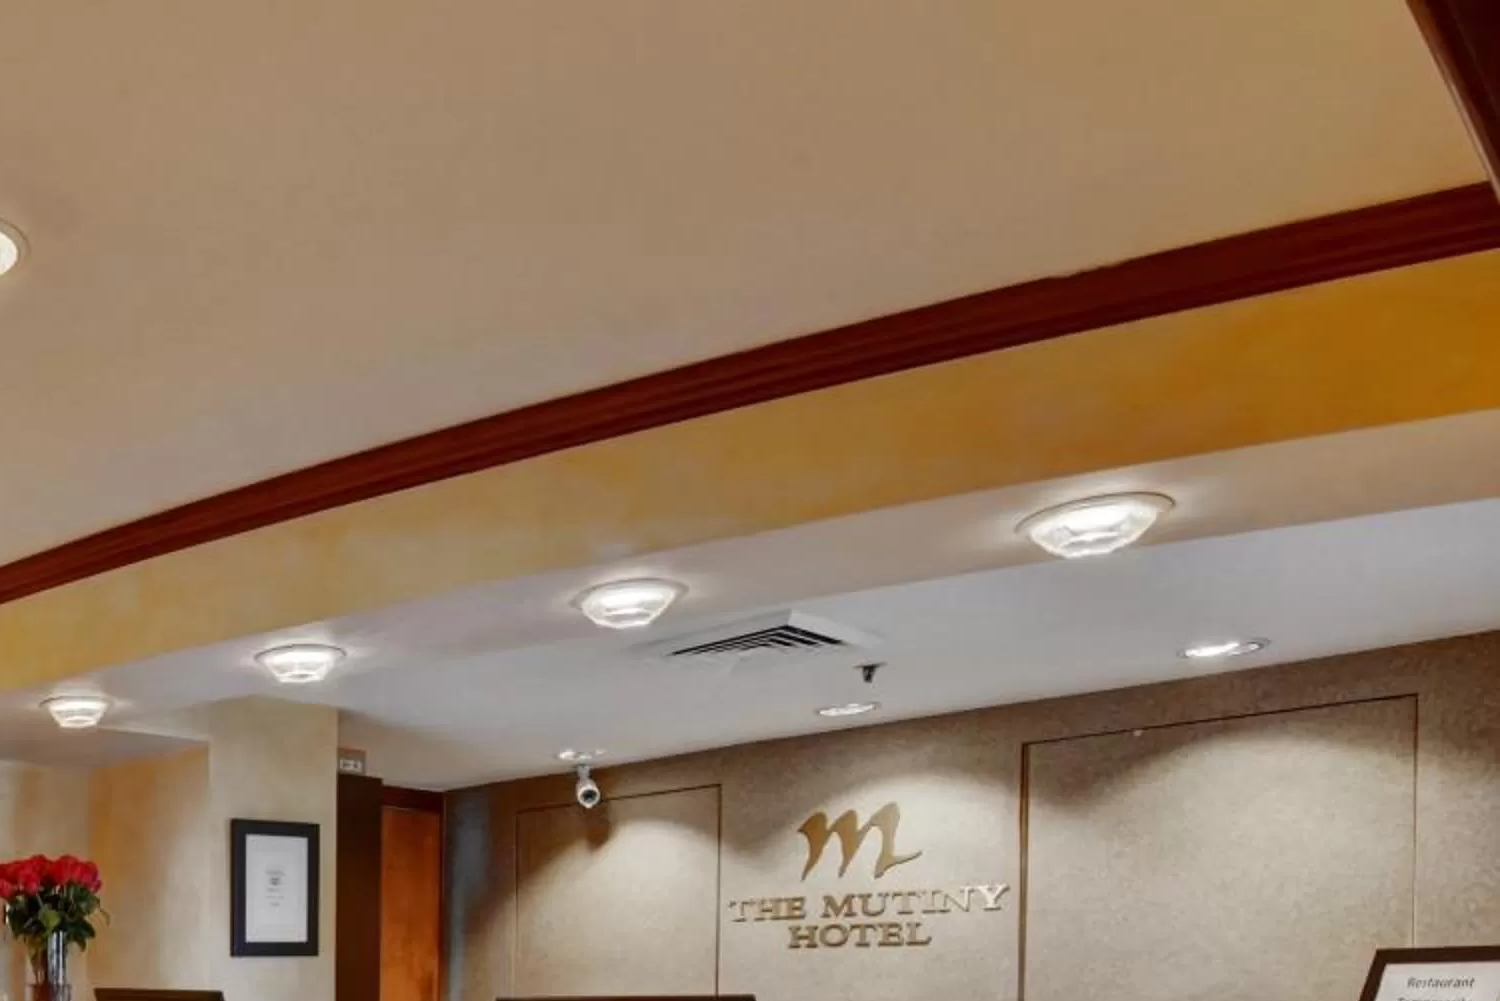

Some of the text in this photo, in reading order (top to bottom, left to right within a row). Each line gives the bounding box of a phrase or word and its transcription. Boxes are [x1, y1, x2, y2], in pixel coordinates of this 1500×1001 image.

[728, 884, 1010, 922] THE MUTINY
[787, 922, 932, 949] HOTEL
[1407, 976, 1475, 989] Restaurant
